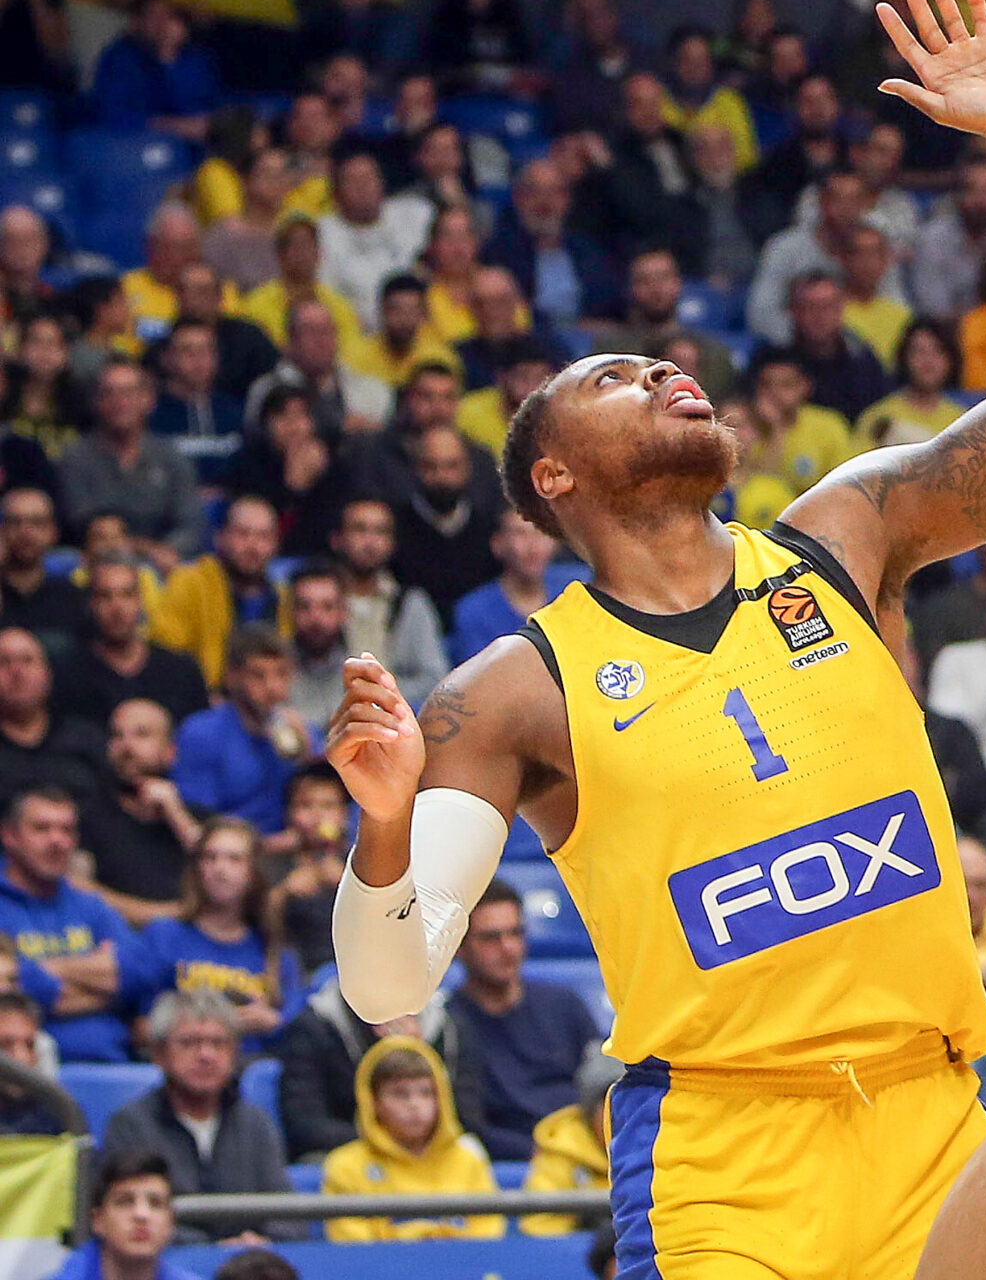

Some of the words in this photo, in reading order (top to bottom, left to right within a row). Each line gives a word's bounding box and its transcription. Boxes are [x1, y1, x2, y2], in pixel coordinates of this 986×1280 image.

[785, 616, 822, 636] TURKISH
[789, 622, 827, 642] AIRLINES
[721, 687, 789, 782] 1
[701, 812, 924, 946] FOX
